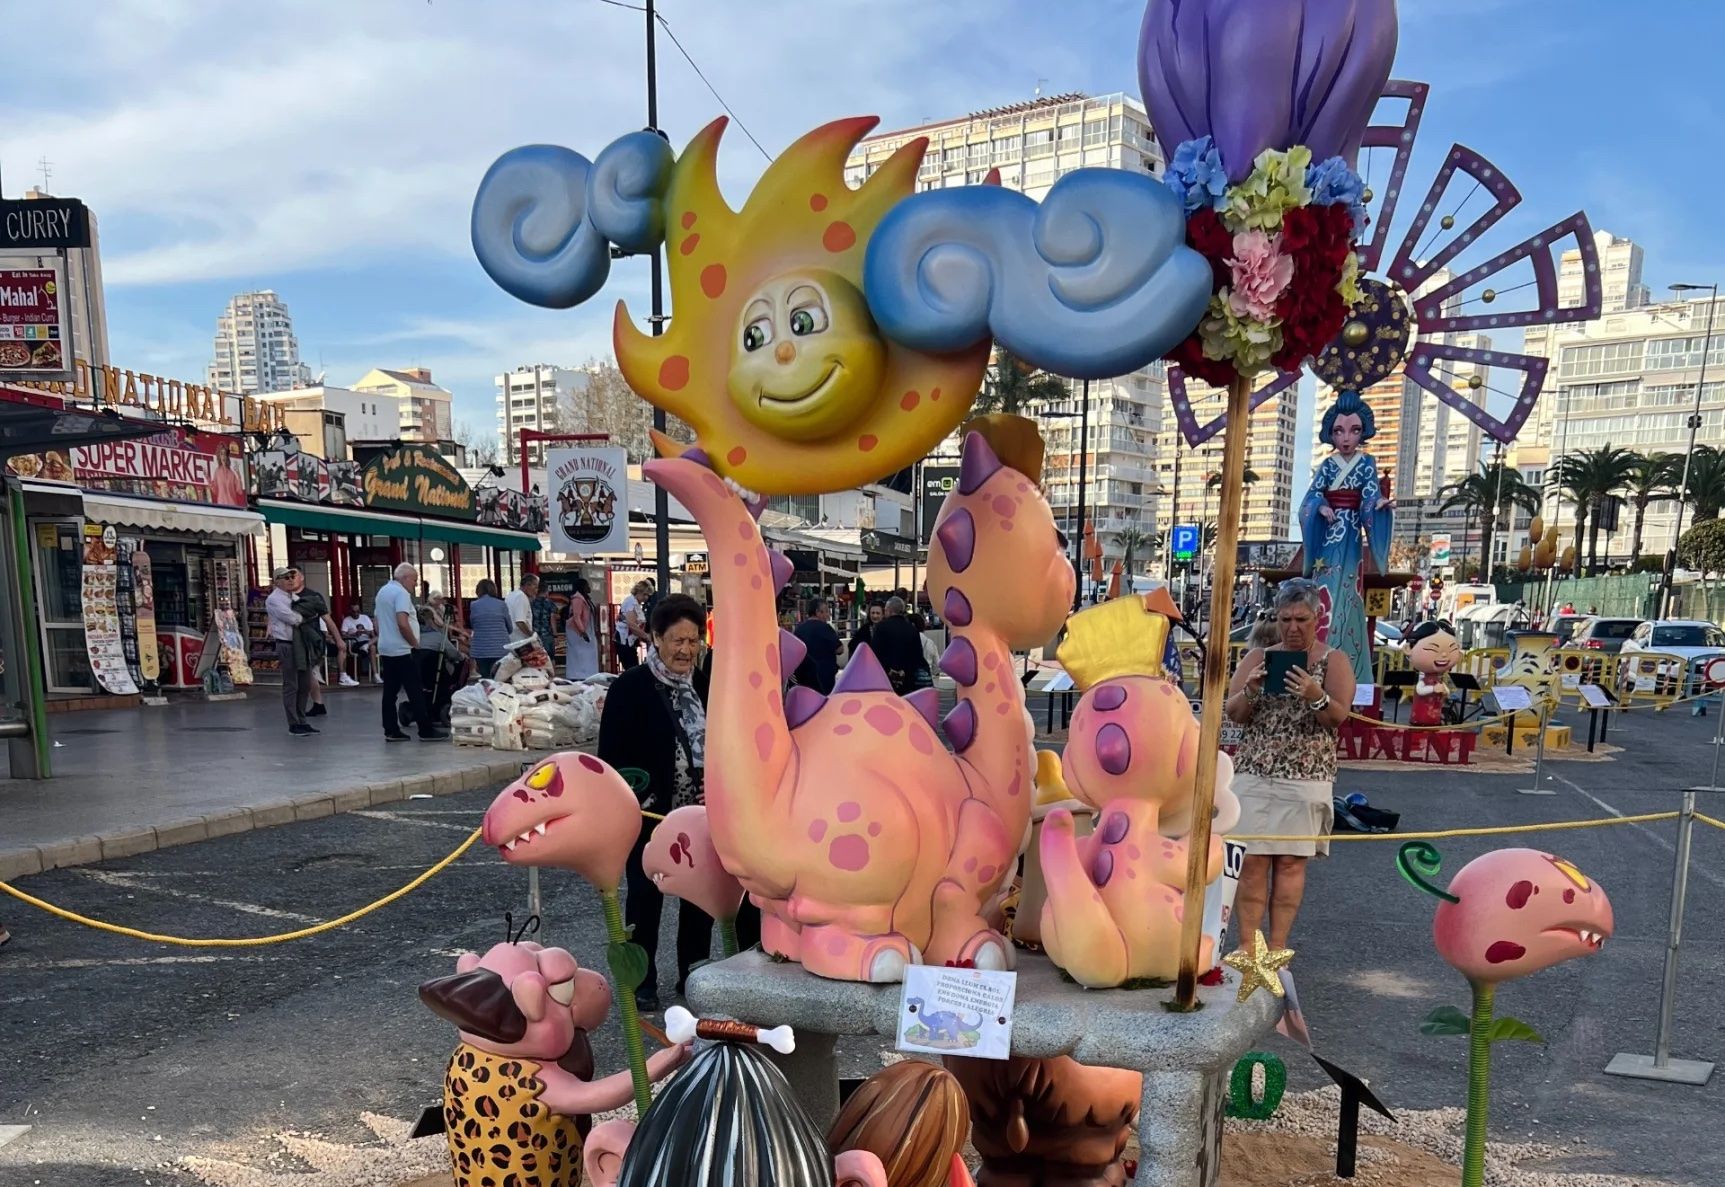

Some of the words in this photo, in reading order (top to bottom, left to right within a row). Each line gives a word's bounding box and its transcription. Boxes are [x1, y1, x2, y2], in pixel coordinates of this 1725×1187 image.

[6, 207, 71, 241] CURRY
[0, 286, 38, 306] Mahal
[3, 313, 20, 324] Burger
[24, 313, 40, 322] Indian
[41, 313, 56, 323] Curry
[102, 364, 232, 426] NATIONAL
[243, 396, 286, 433] BAR
[77, 442, 138, 474] SUPER
[141, 445, 214, 483] MARKET
[555, 458, 579, 480] GRAND
[580, 456, 616, 480] NATIONAL
[365, 466, 408, 505] Grand
[415, 474, 470, 509] National
[1178, 530, 1193, 549] P
[688, 563, 707, 571] ATM
